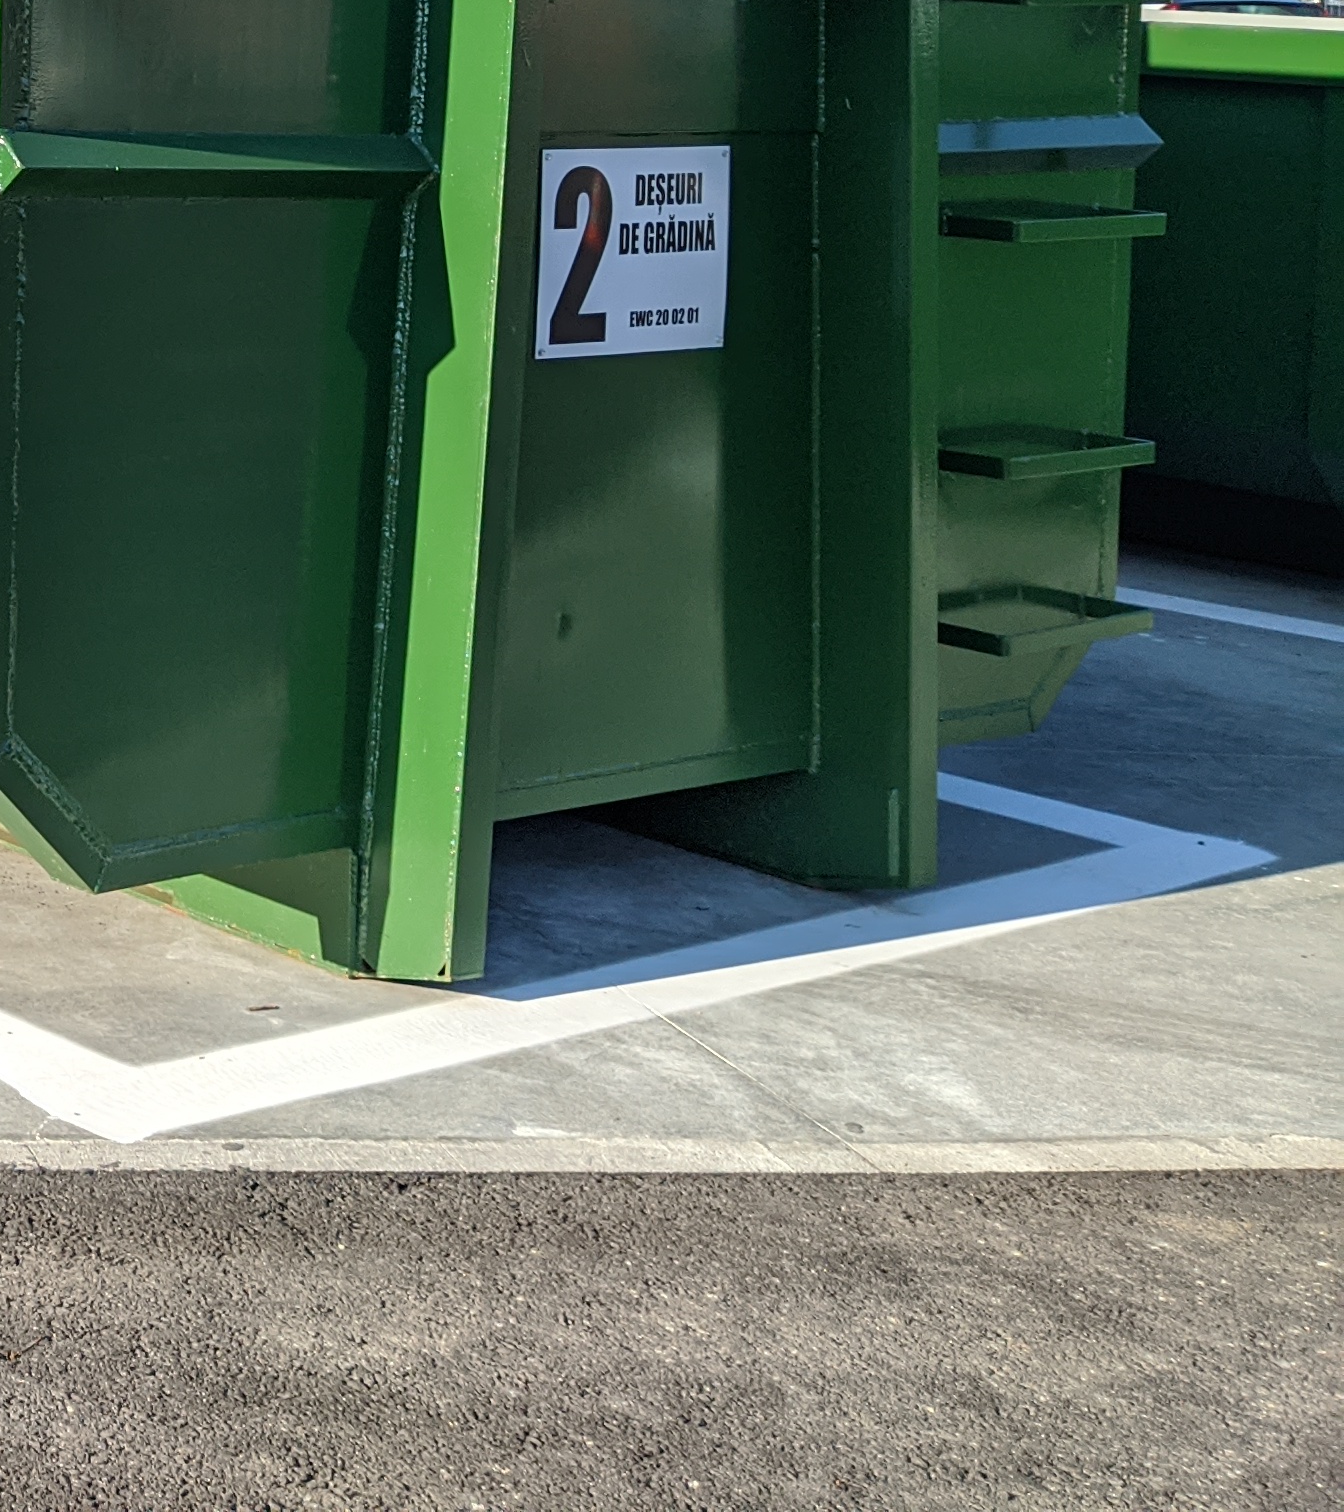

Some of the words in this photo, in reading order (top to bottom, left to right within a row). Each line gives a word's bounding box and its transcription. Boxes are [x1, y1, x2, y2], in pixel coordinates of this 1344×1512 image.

[549, 165, 613, 345] 2
[619, 223, 639, 255] DE
[644, 212, 716, 255] GRĂDINĂ
[629, 309, 653, 328] EWC
[656, 308, 669, 326] 20
[672, 307, 685, 325] 02
[687, 306, 700, 324] 01
